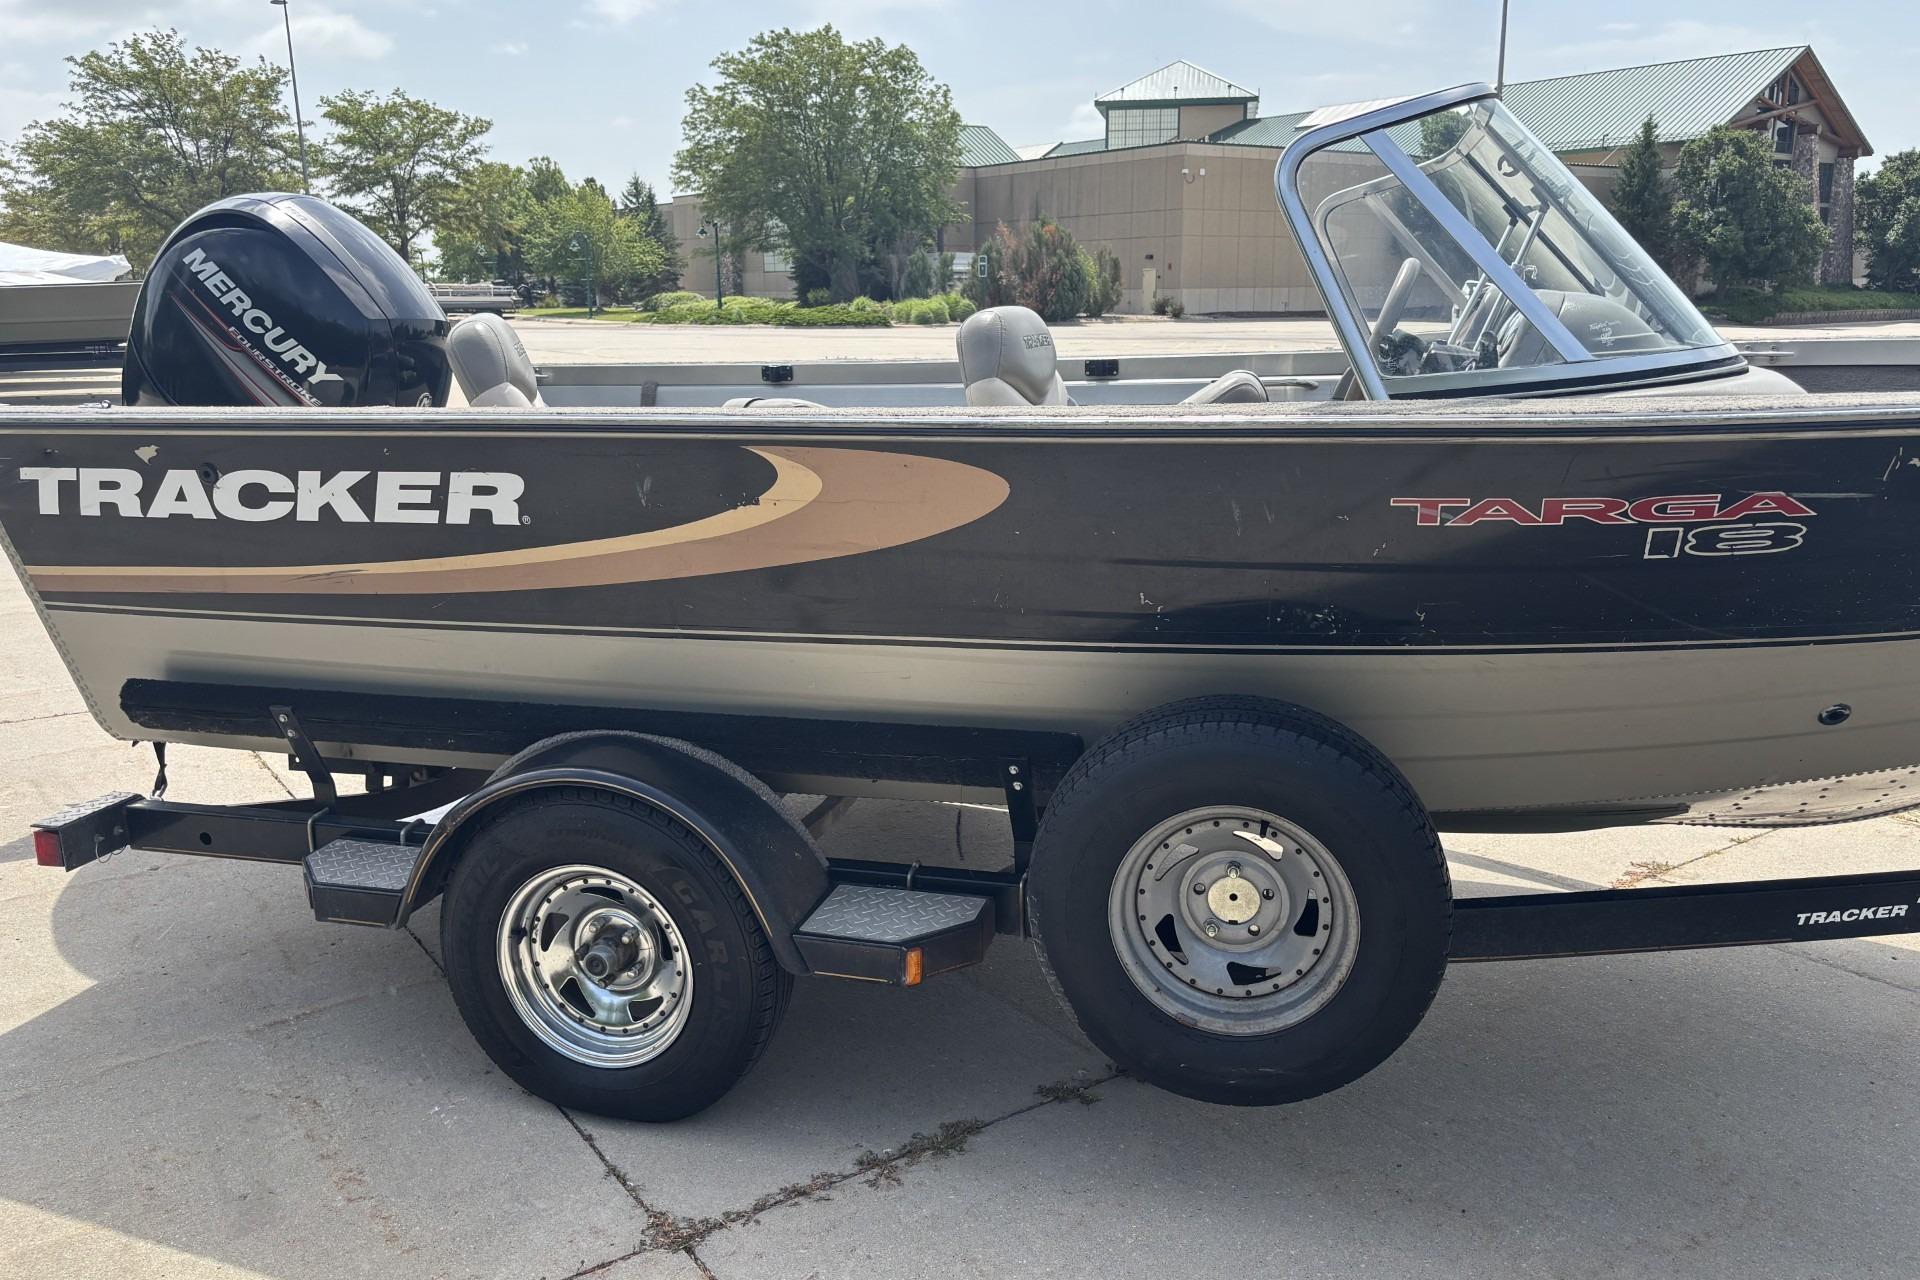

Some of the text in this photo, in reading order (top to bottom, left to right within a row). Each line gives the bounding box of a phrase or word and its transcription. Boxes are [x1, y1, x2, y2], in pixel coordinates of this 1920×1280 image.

[182, 247, 344, 385] MERCURY
[228, 326, 322, 407] FOURSTROKE
[19, 467, 523, 526] TRACKER
[1390, 491, 1818, 526] TARGA
[1643, 522, 1808, 560] 18
[1796, 904, 1909, 926] TRACKER
